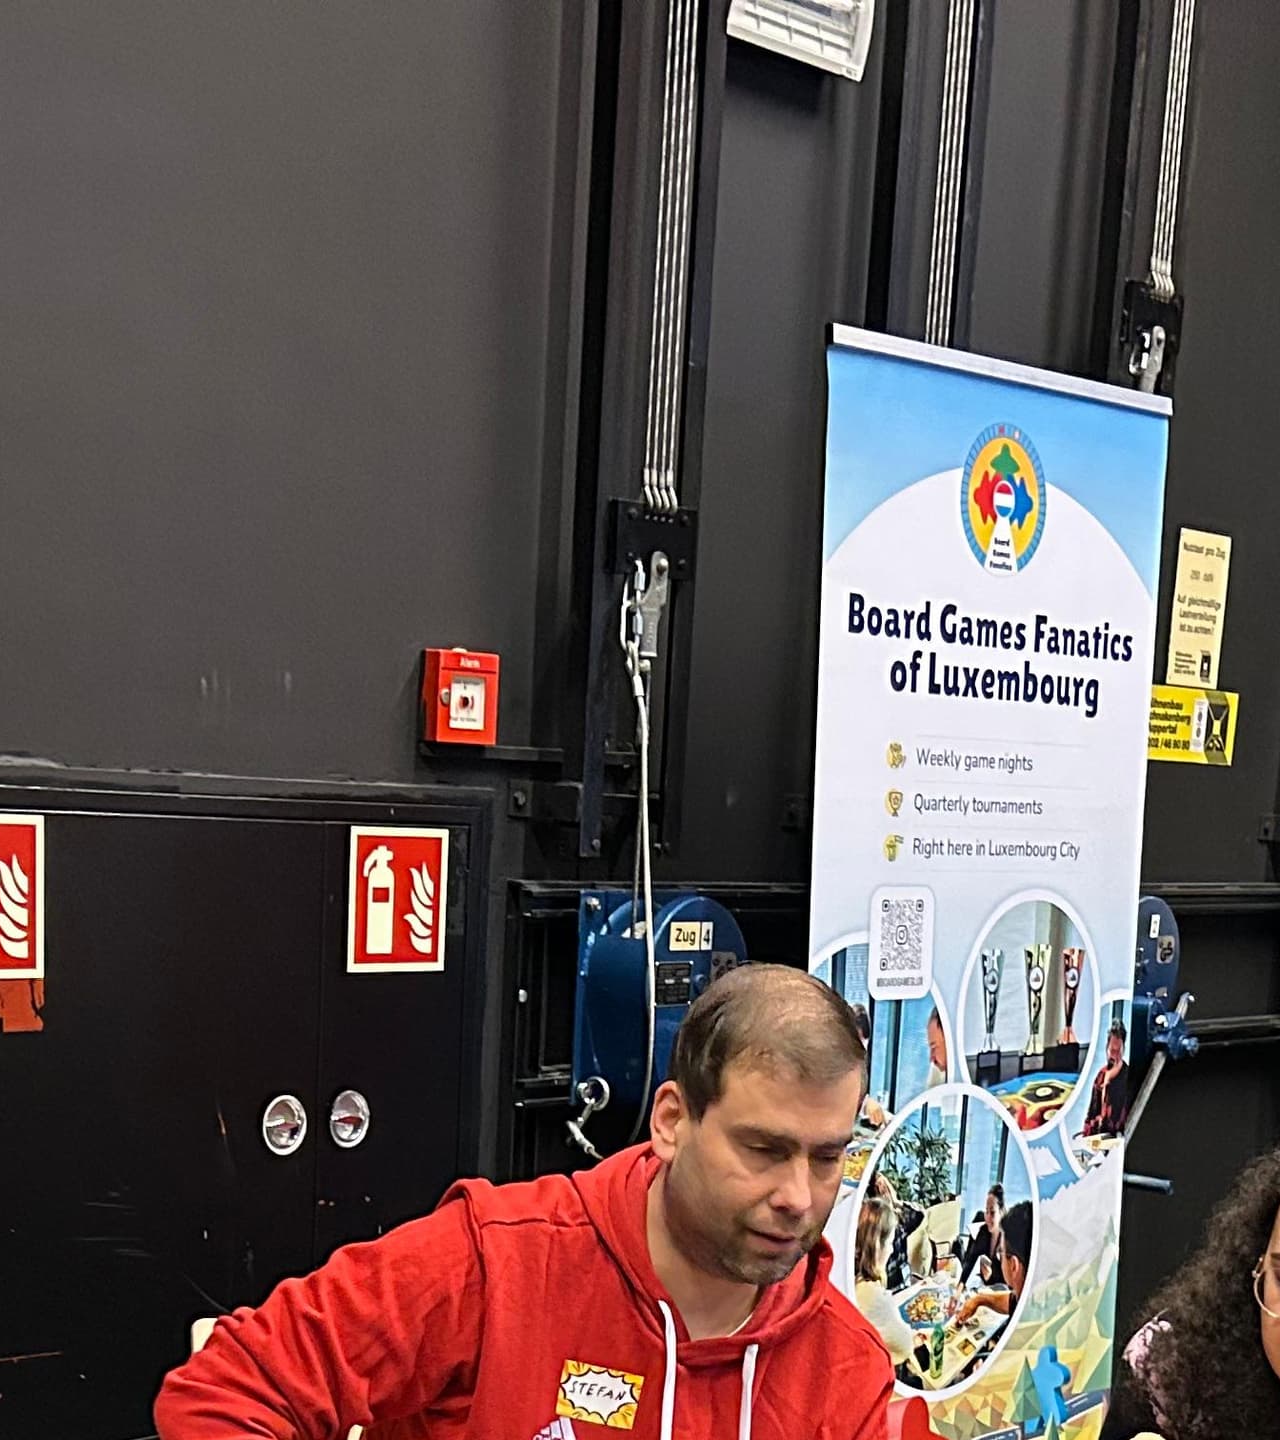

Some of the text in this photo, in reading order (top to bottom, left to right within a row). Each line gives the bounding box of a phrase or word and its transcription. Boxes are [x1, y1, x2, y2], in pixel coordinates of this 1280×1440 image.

[848, 592, 1133, 662] Board Games Fanatics
[890, 650, 1099, 718] of Luxembourg
[916, 748, 1033, 774] Weekly game nights
[914, 793, 1043, 816] Quarterly tournaments
[913, 838, 1080, 861] Right here in Luxembourg City
[674, 928, 711, 946] Zug 4
[568, 1380, 626, 1401] STEFAN
